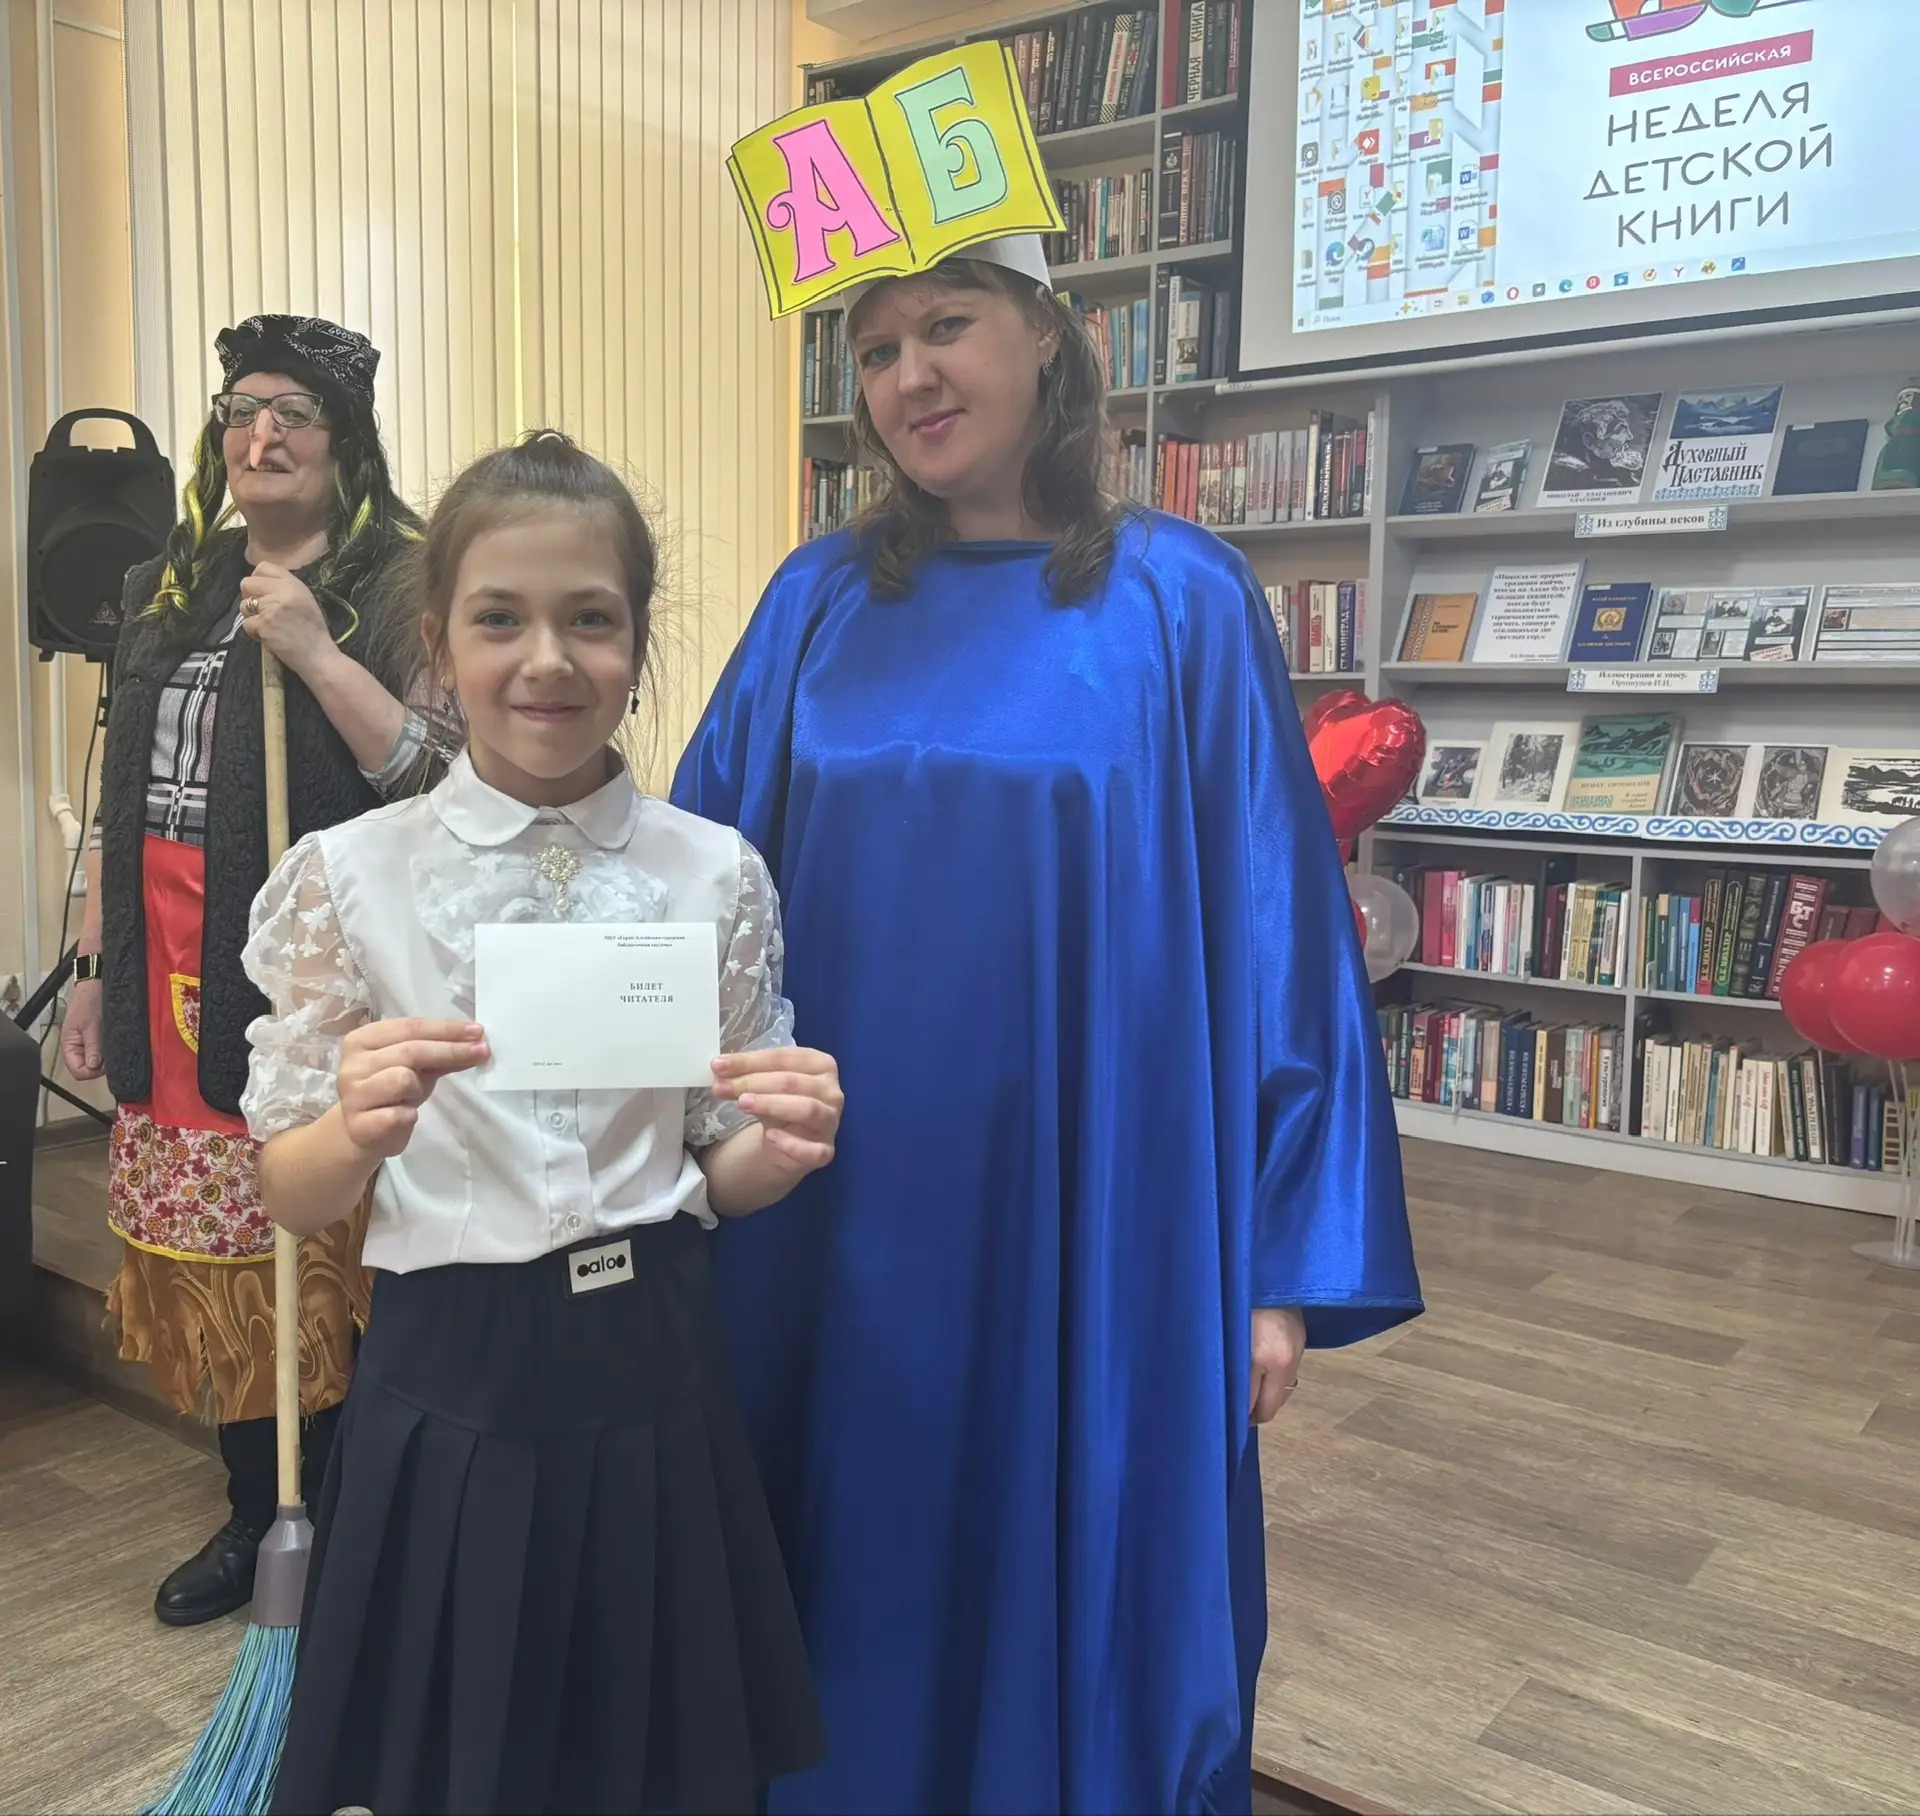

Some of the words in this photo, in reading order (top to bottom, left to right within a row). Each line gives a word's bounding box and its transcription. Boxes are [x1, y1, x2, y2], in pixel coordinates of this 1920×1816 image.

[1190, 3, 1205, 43] КНИГА
[1188, 56, 1201, 100] ЧЕРНАЯ
[1628, 45, 1792, 86] ВСЕРОССИЙСКАЯ
[1607, 81, 1809, 147] НЕДЕЛЯ
[767, 119, 900, 282] А
[894, 66, 1007, 225] Б
[1582, 123, 1832, 200] ДЕТСКОЙ
[1617, 191, 1788, 247] КНИГИ
[1597, 518, 1612, 529] Из
[1615, 515, 1666, 530] глубины
[1670, 515, 1705, 525] веков
[620, 995, 674, 1003] ЧИТАТЕЛЯ
[630, 982, 664, 991] БИЛЕТ
